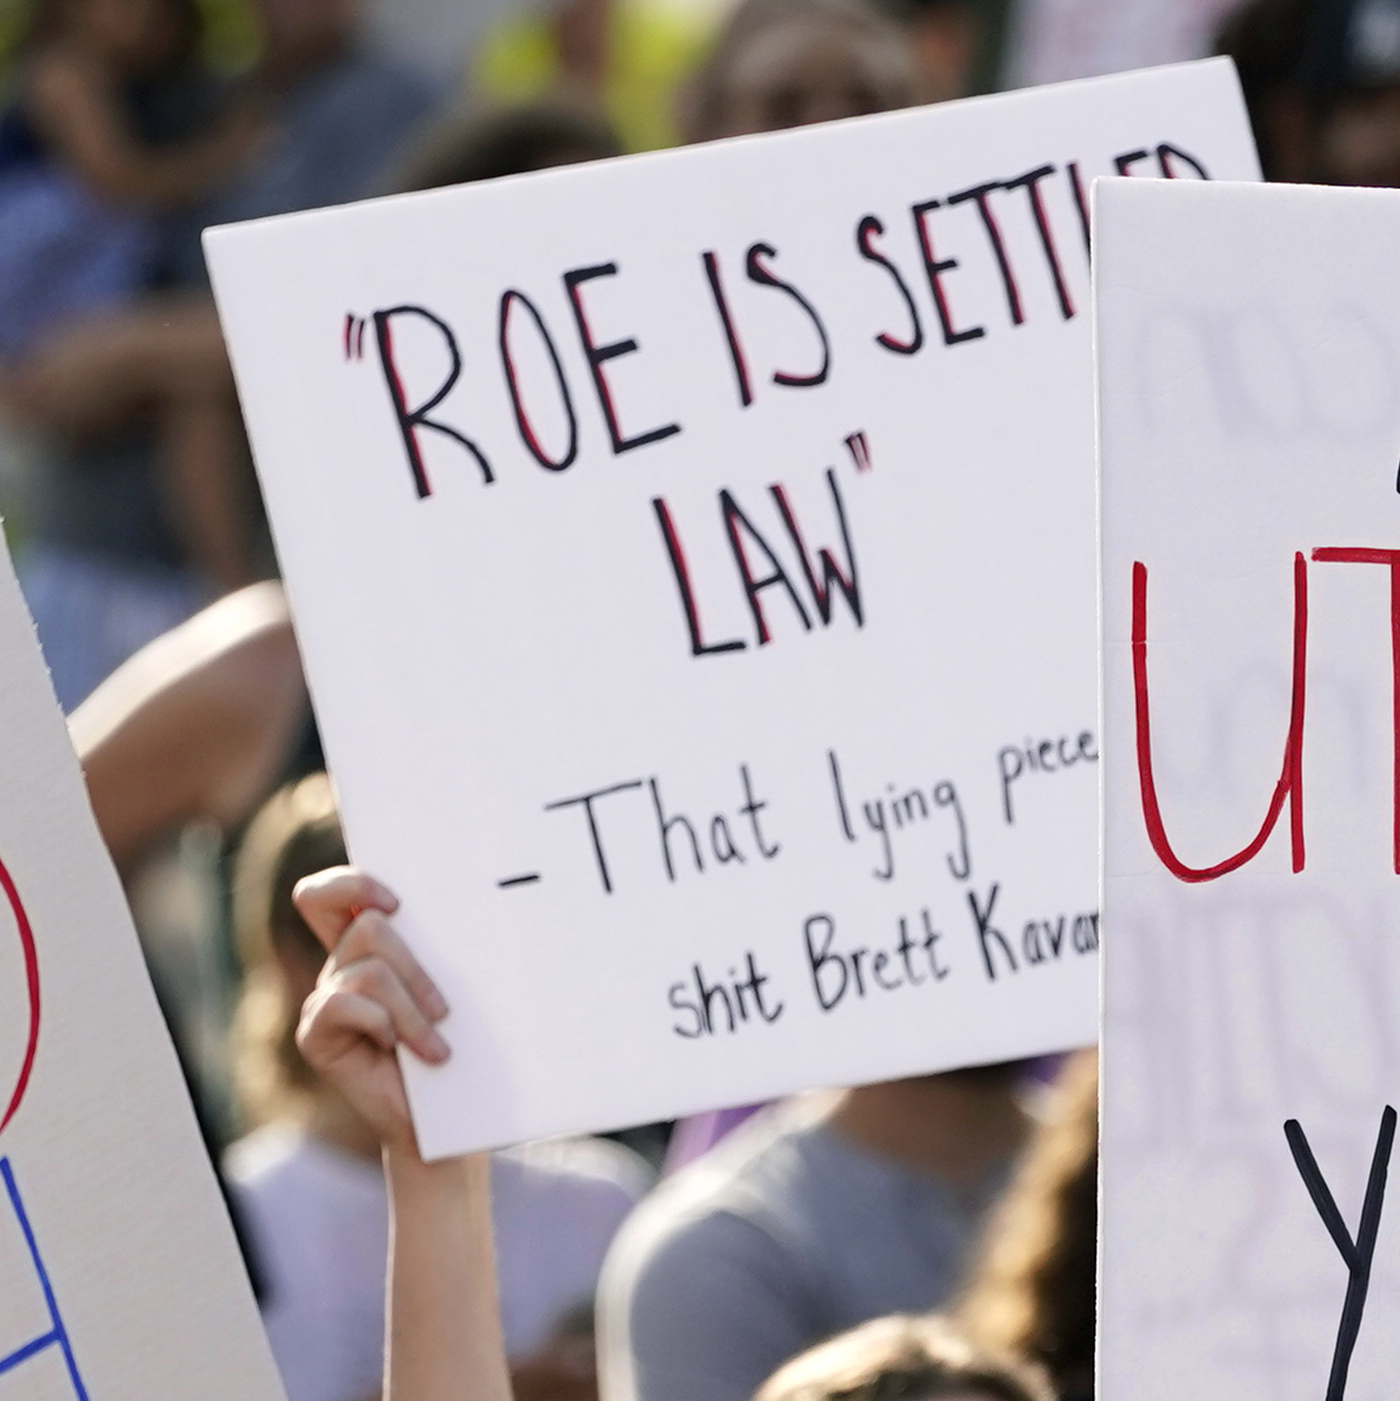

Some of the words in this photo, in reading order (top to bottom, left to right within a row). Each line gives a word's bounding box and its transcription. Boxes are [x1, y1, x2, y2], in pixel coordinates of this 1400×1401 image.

[343, 261, 683, 500] "ROE
[702, 242, 831, 408] IS
[639, 428, 874, 657] LAW"
[827, 748, 971, 882] lying
[997, 728, 1099, 826] piece
[667, 950, 784, 1040] shit
[802, 908, 952, 1014] Brett
